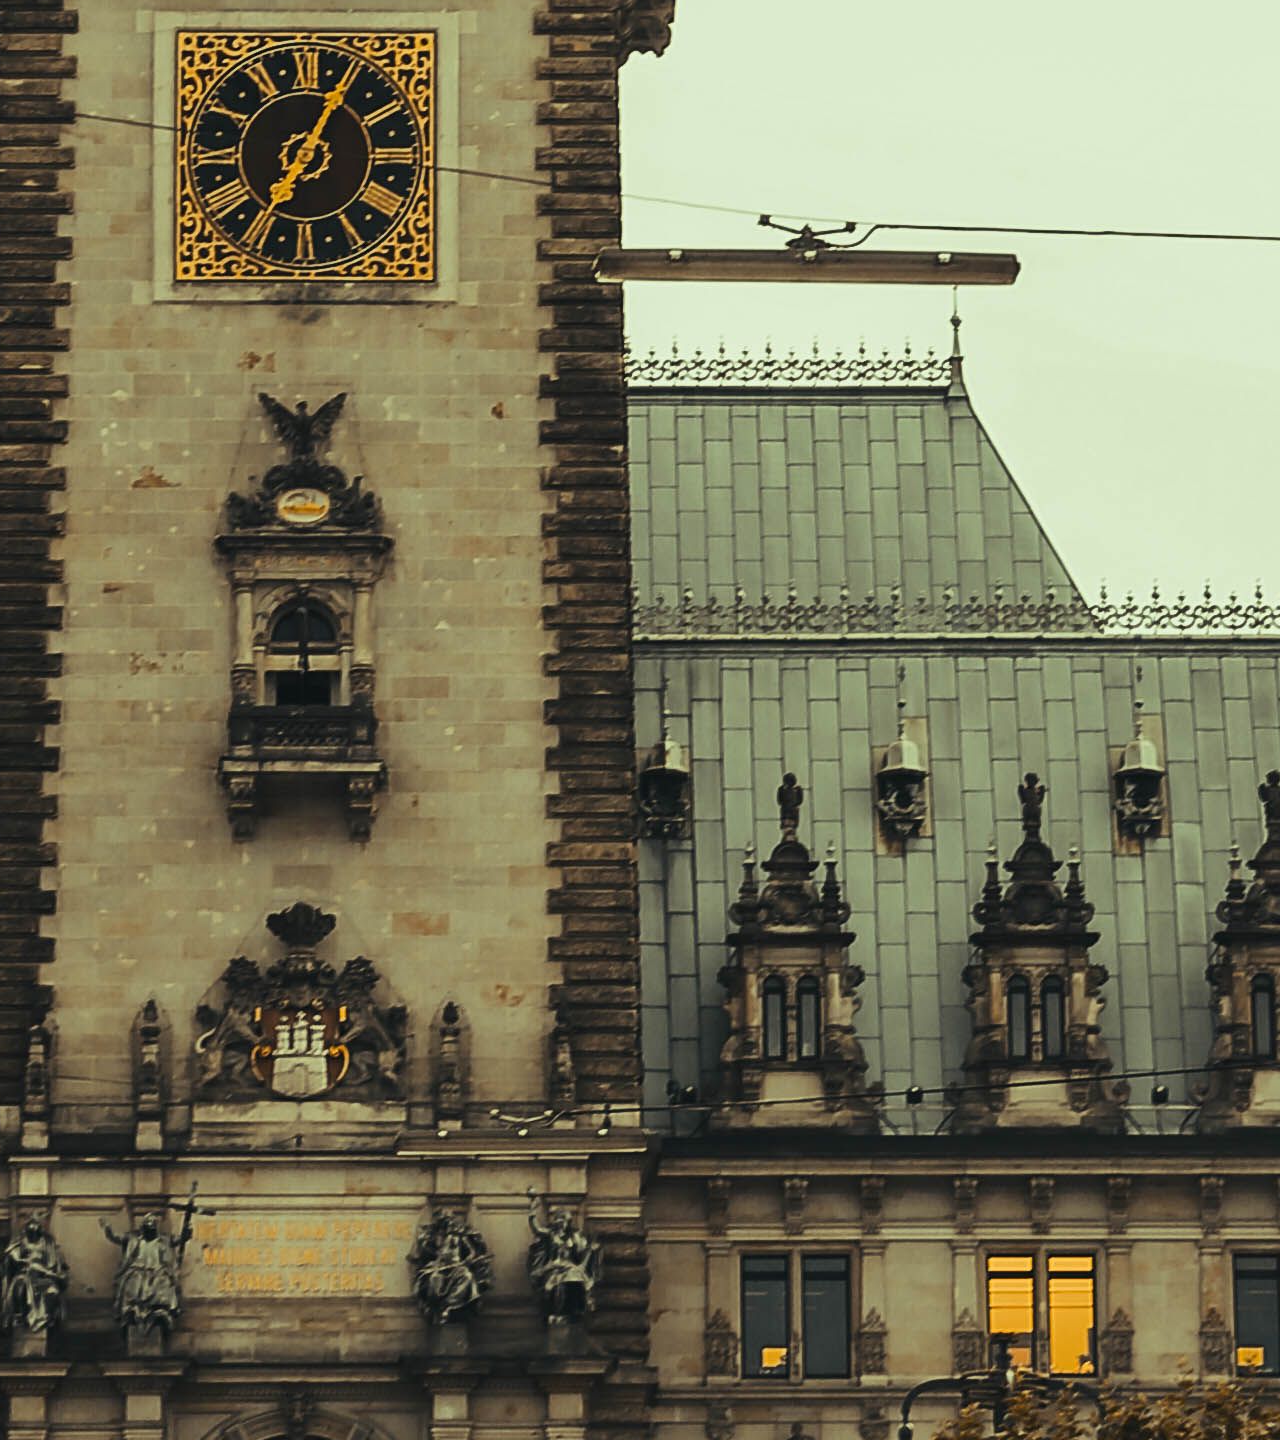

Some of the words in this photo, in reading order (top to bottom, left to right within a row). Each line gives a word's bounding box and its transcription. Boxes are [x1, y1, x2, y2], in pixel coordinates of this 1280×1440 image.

[292, 51, 320, 90] XII
[363, 100, 402, 127] II
[374, 147, 414, 166] III
